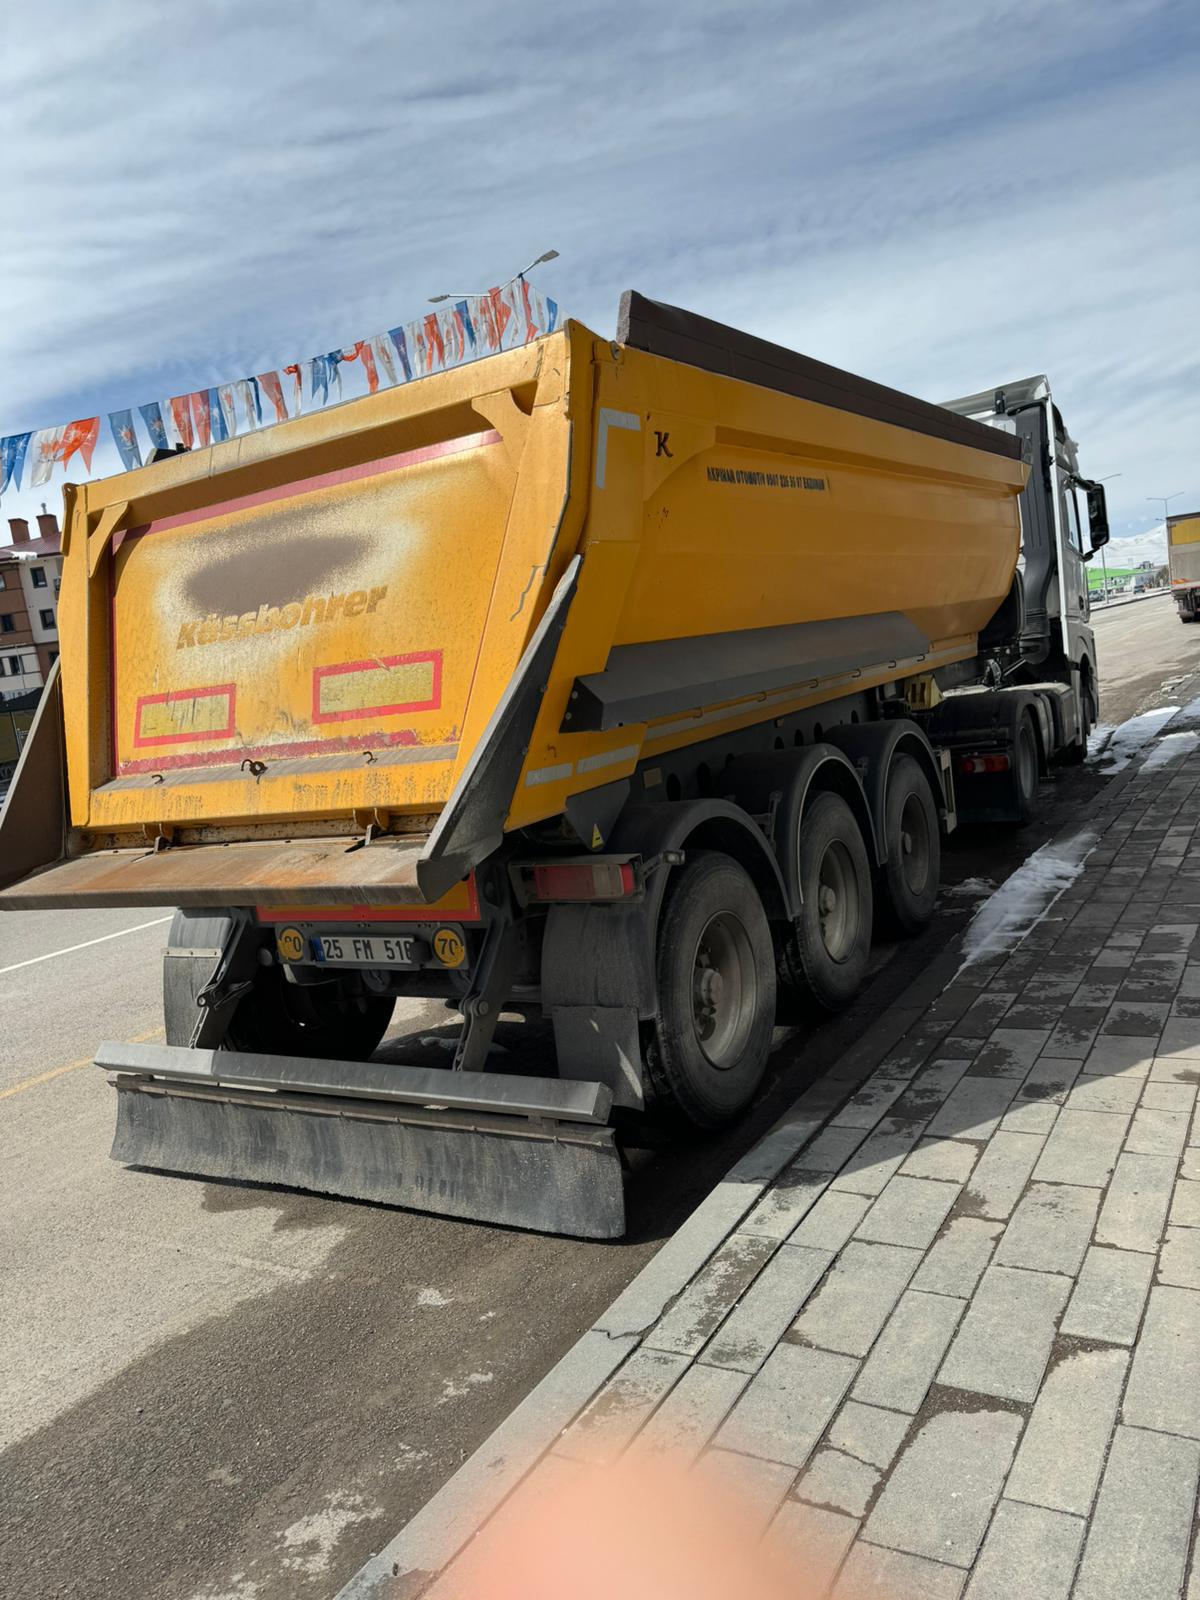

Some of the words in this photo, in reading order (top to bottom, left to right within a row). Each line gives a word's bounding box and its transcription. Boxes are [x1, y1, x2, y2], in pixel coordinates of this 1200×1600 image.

[654, 431, 673, 457] K
[323, 939, 343, 959] 25
[353, 939, 374, 960] FM
